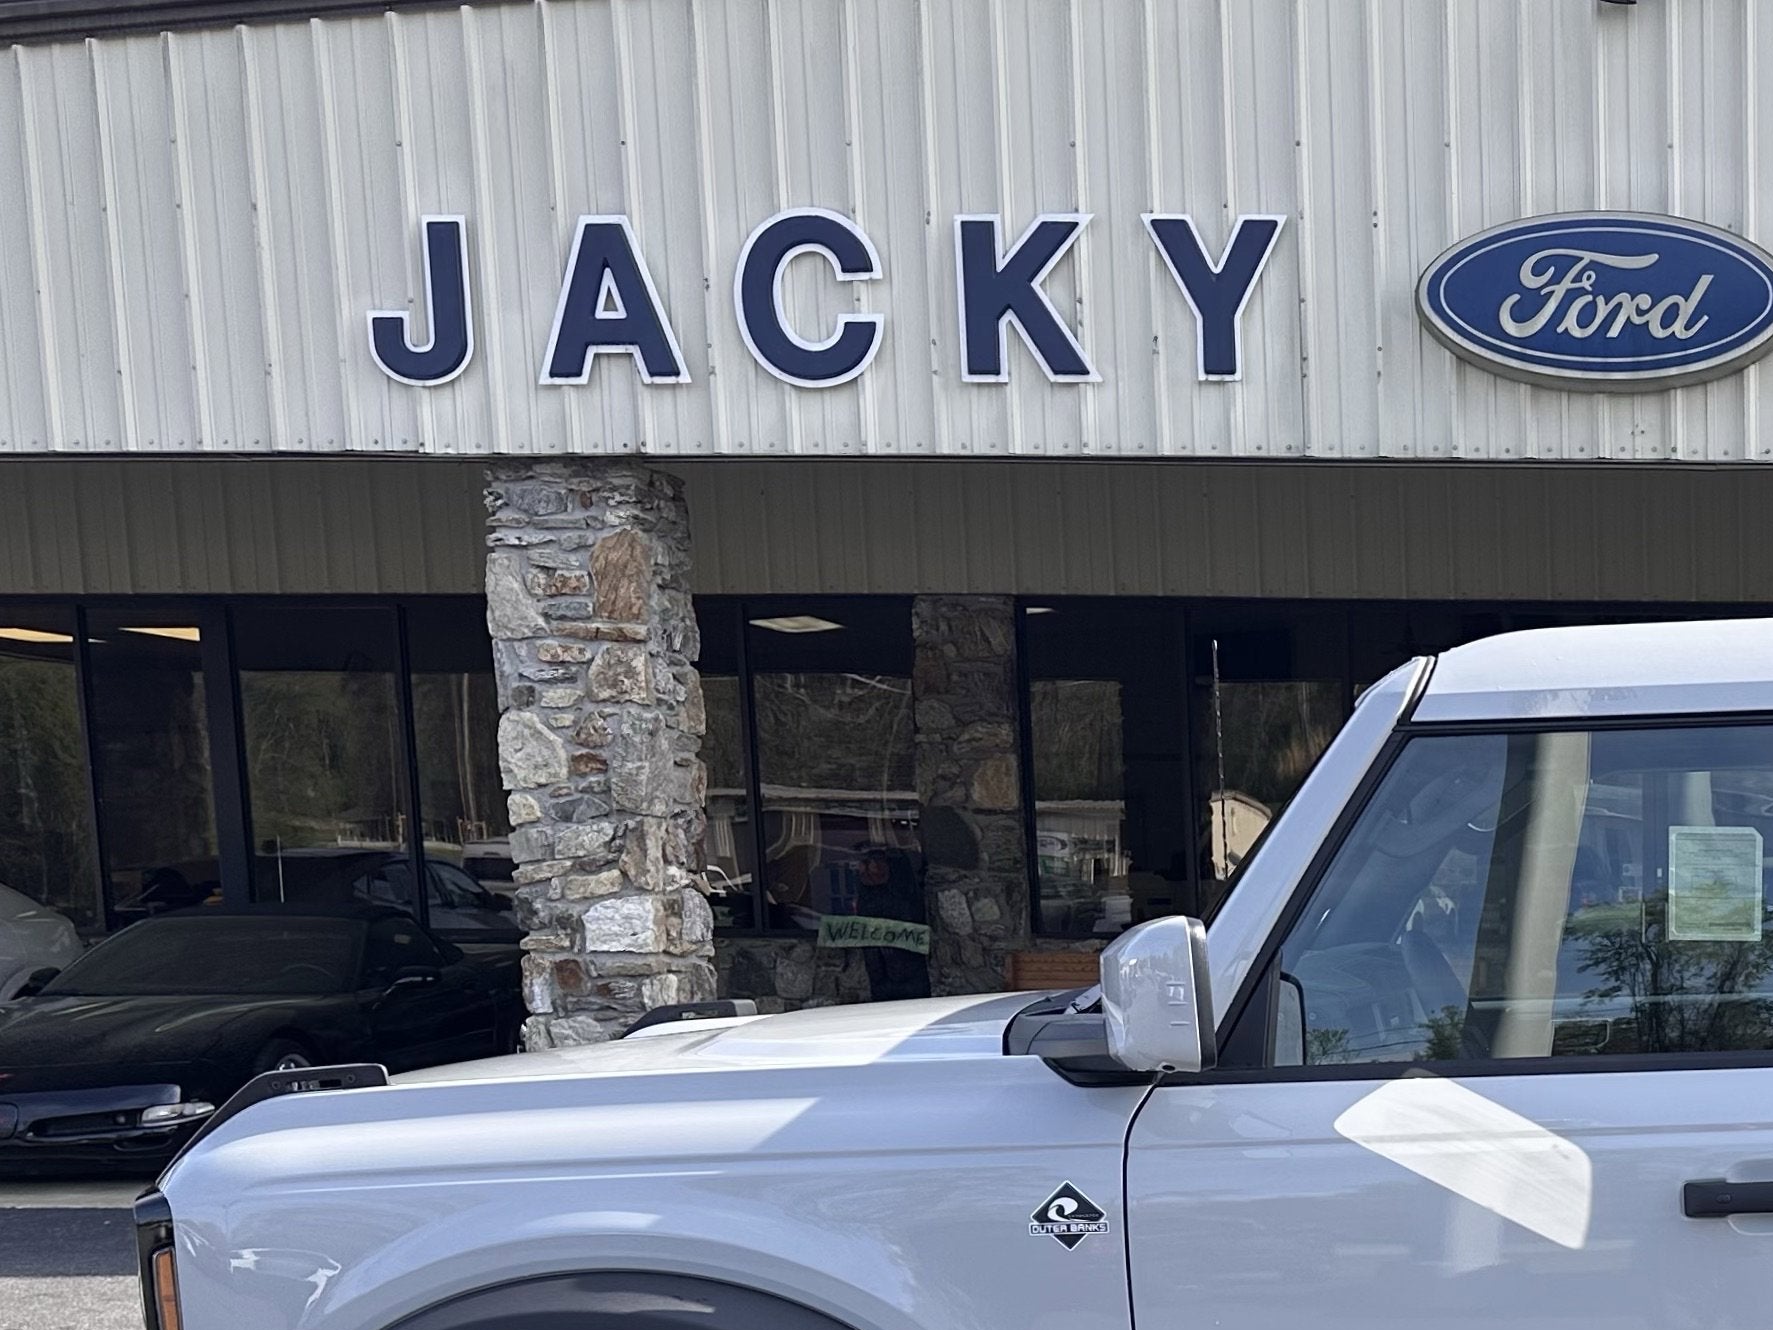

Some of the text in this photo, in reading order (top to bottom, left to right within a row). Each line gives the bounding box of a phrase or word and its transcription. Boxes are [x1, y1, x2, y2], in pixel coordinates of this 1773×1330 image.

[367, 207, 1288, 387] JACKY
[1499, 247, 1714, 339] Ford
[827, 921, 926, 946] WELCOME
[1032, 1223, 1106, 1233] OUTER BANKS
